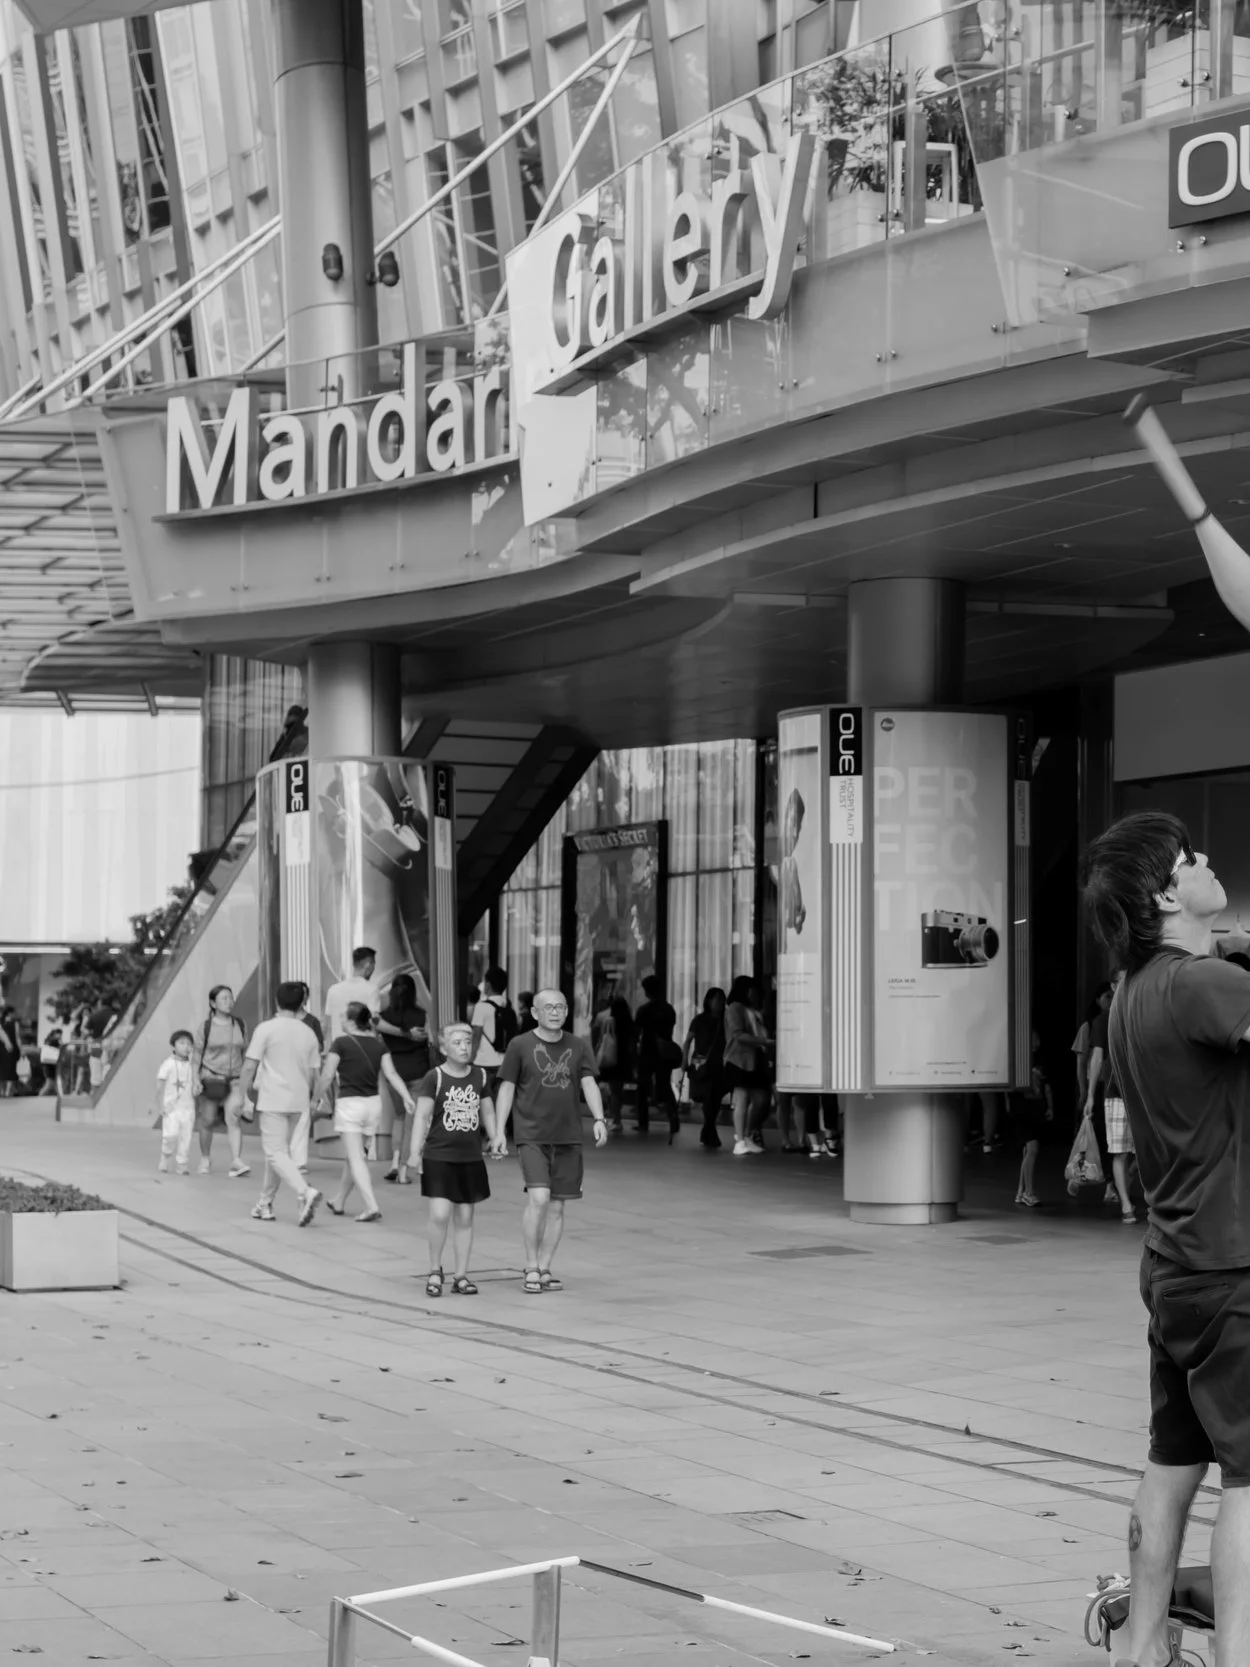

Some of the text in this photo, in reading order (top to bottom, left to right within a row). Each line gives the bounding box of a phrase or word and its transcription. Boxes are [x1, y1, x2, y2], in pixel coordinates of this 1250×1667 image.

[550, 134, 810, 366] Gallery
[838, 712, 855, 774] OUE
[290, 764, 304, 812] OUE
[873, 767, 979, 818] PER
[873, 824, 979, 874] FEC
